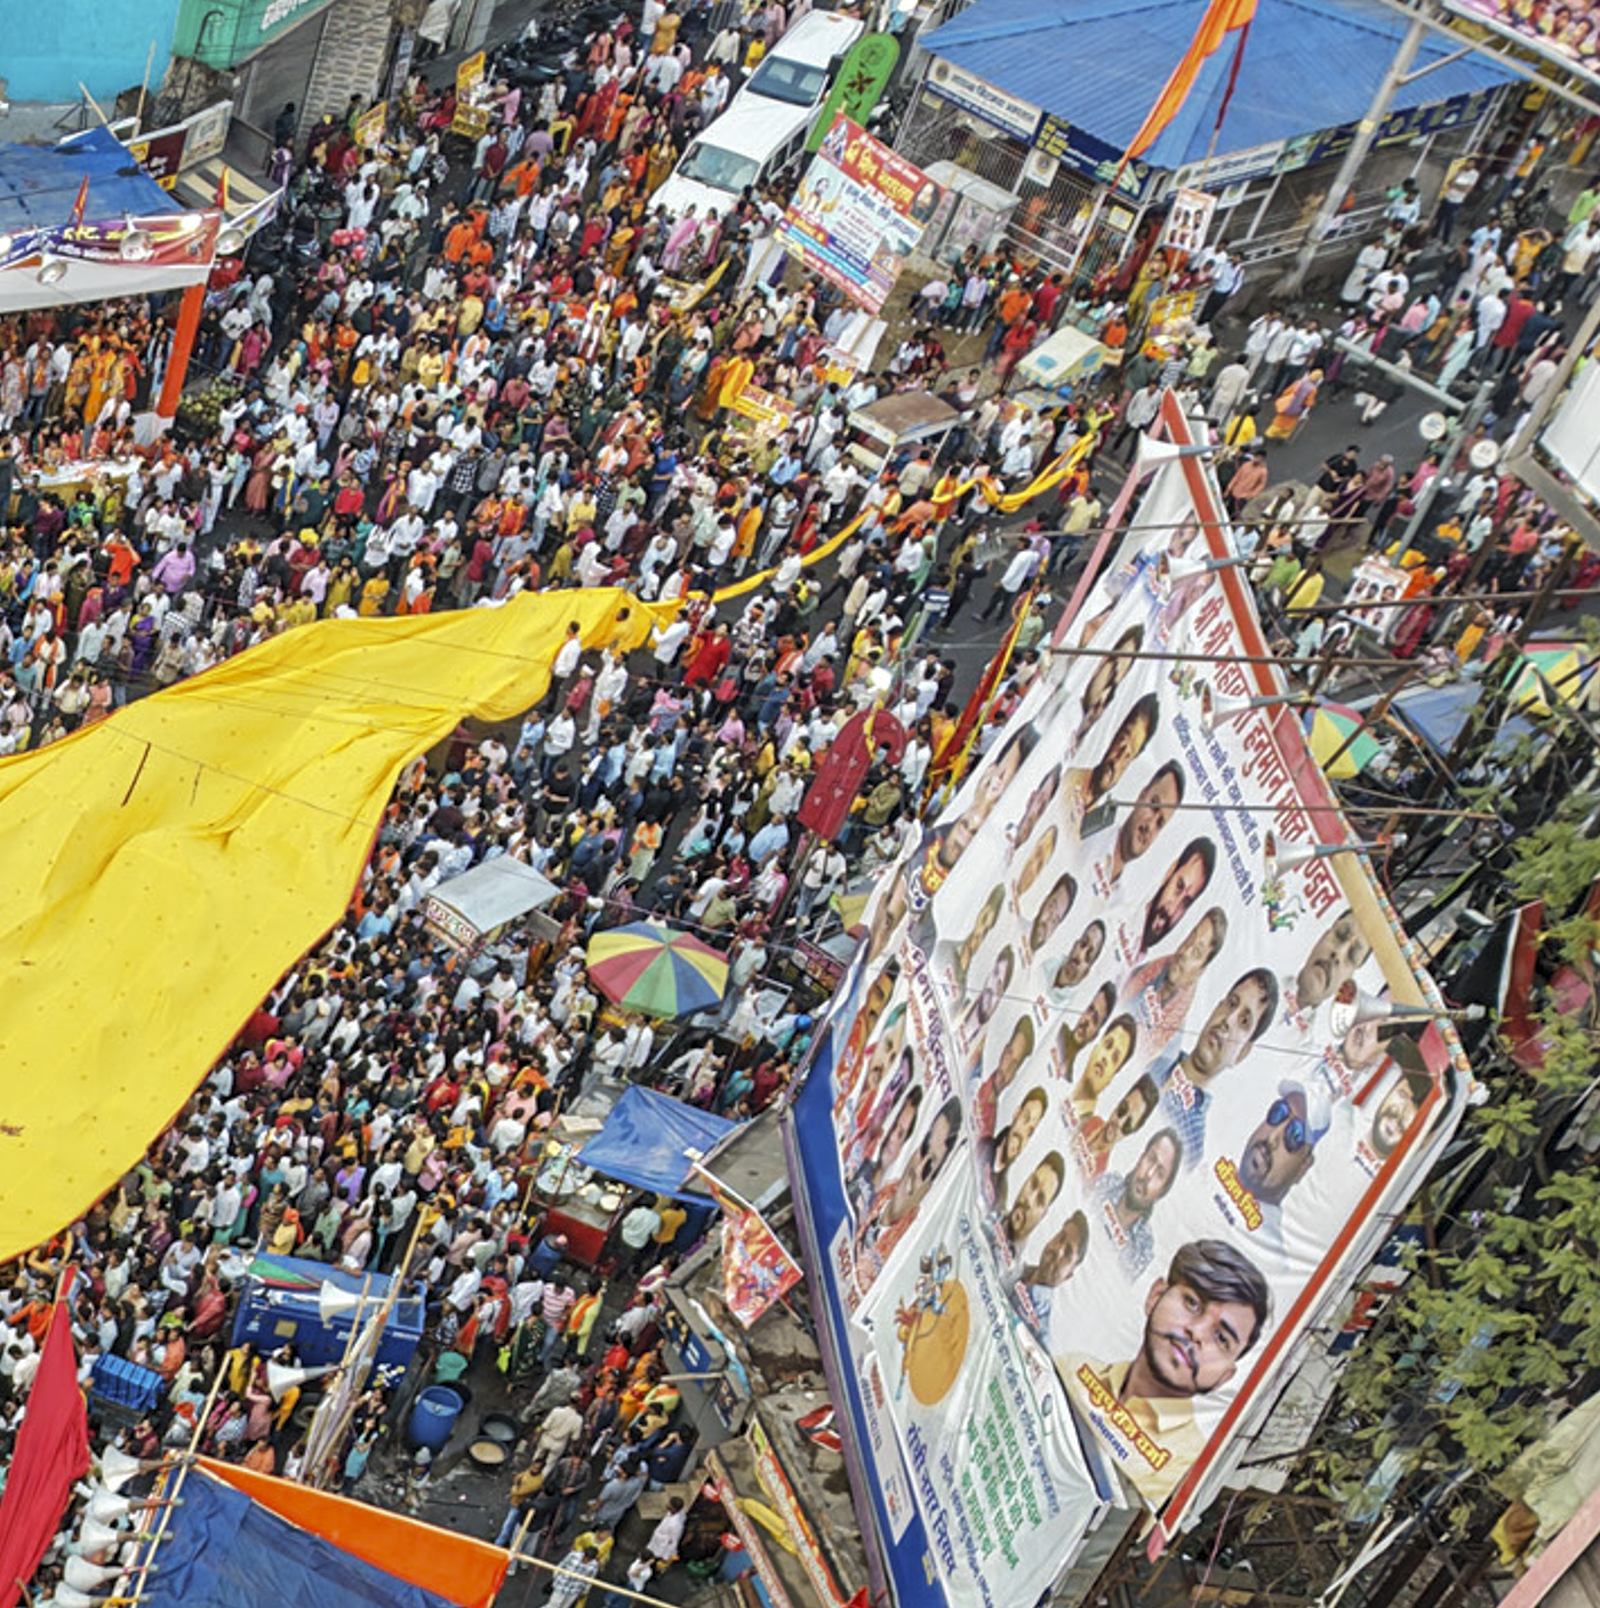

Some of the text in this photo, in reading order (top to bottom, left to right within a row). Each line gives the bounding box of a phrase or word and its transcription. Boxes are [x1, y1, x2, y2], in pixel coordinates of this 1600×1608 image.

[1190, 595, 1227, 636] श्री
[1199, 620, 1236, 658] श्री
[1239, 718, 1290, 803] हनुमान
[901, 1421, 928, 1475] रांची
